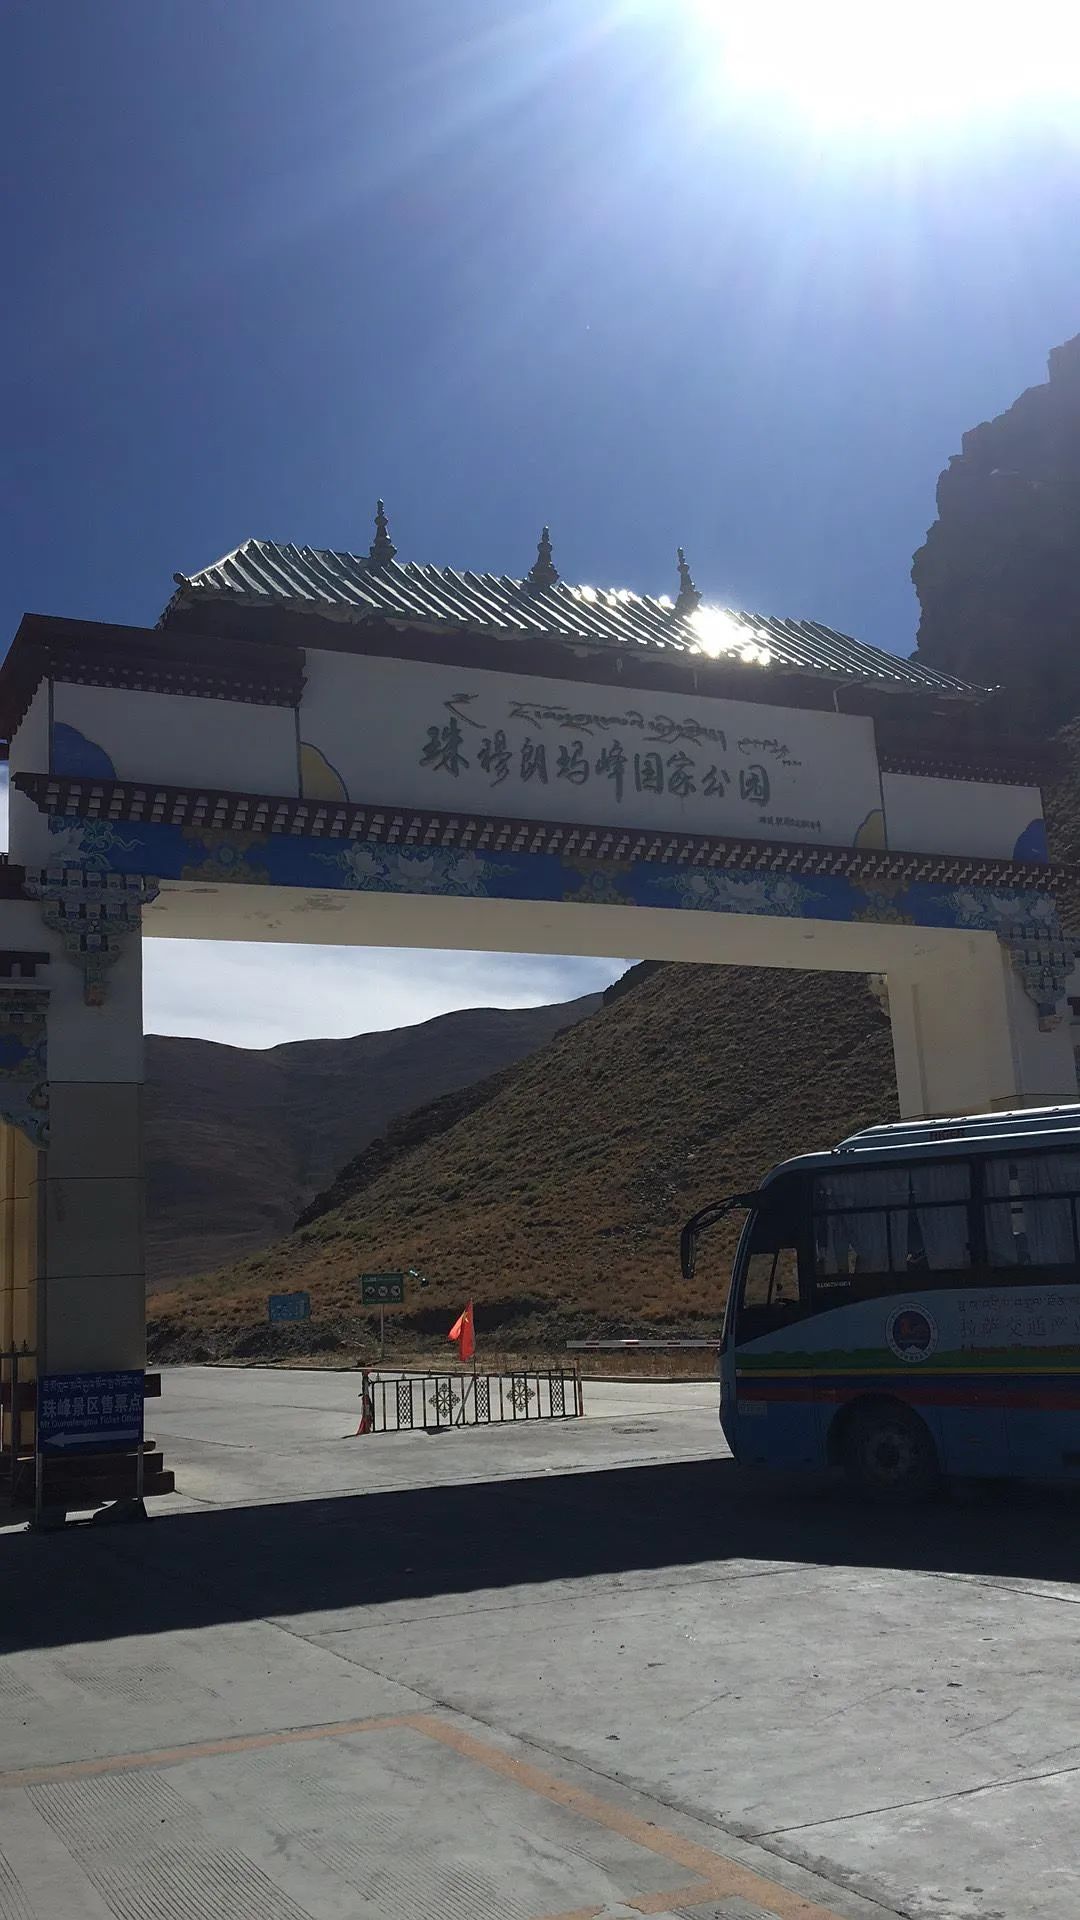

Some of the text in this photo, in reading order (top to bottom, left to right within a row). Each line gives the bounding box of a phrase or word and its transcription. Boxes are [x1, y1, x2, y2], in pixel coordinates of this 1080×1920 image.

[418, 716, 772, 807] 珠穆朗玛峰国家公园
[42, 1393, 141, 1418] 珠峰景区售票点
